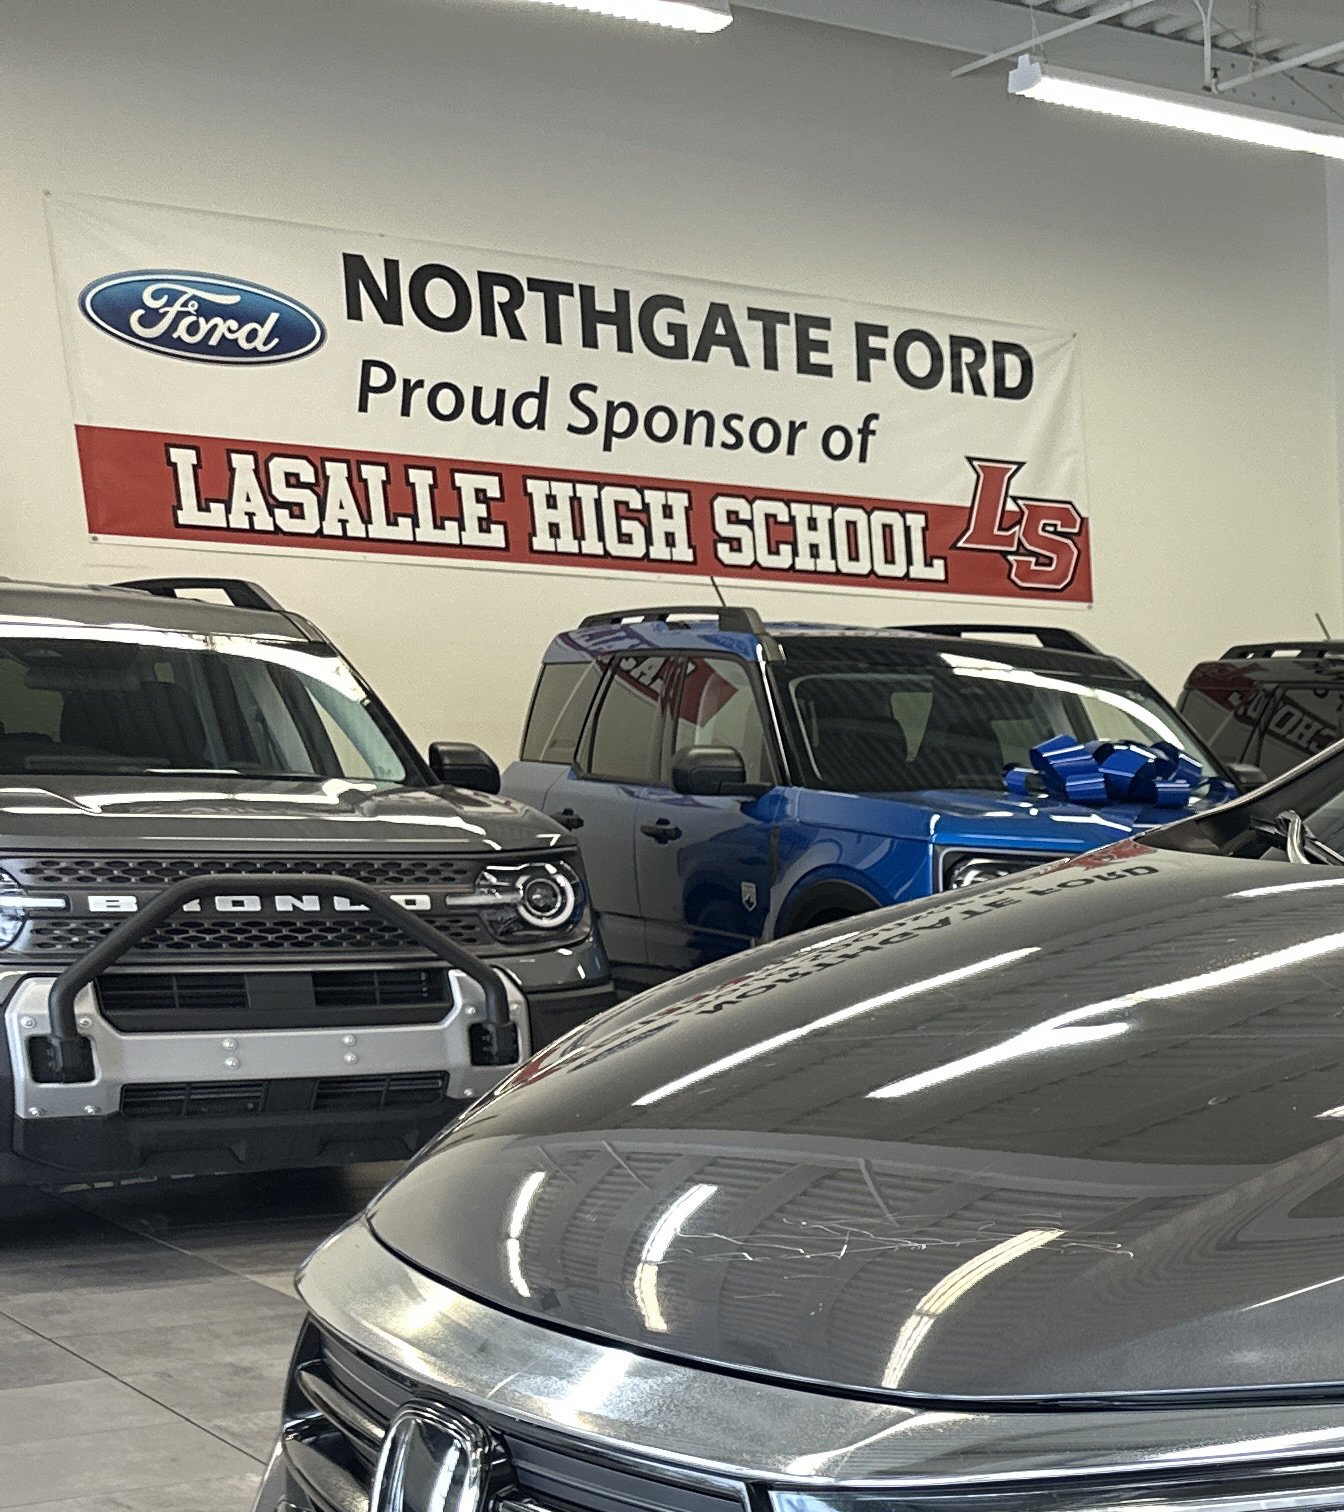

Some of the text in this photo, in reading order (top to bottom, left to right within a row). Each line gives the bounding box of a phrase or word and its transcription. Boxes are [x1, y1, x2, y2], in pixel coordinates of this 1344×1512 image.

[342, 252, 1034, 401] NORTHGATE FORD
[358, 359, 880, 464] Proud Sponsor of
[165, 443, 948, 584] LASALLE HIGH SCHOOL
[949, 455, 1084, 592] LS
